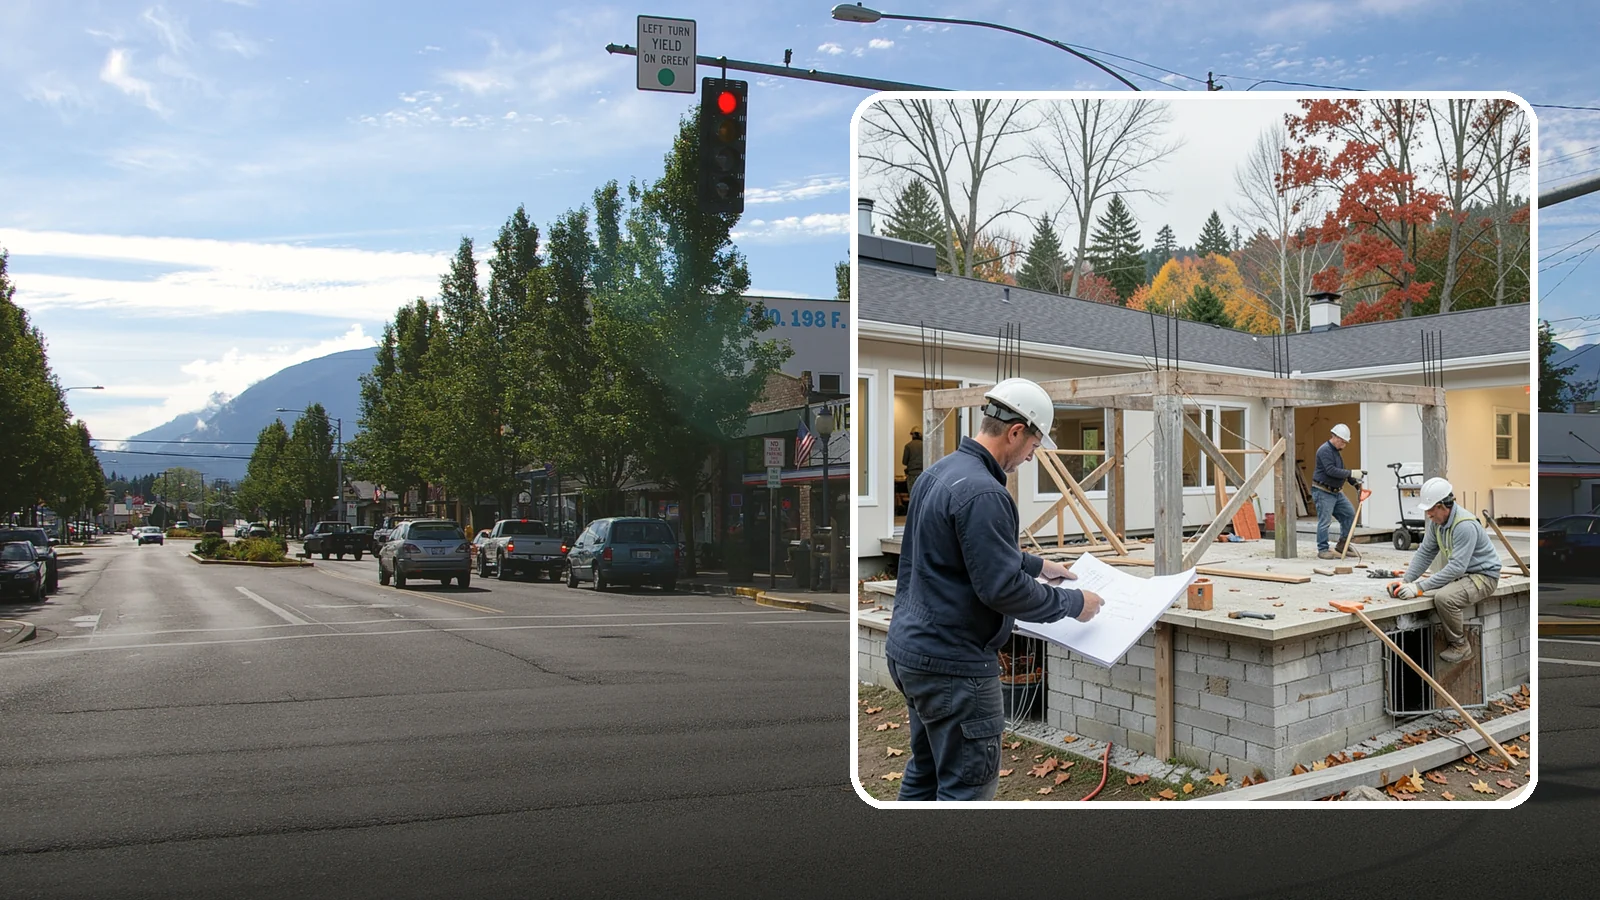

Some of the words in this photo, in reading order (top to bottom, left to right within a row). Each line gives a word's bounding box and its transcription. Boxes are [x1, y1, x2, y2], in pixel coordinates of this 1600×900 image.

[642, 23, 663, 34] LEFT
[668, 25, 690, 36] TURN
[652, 38, 682, 51] YIELD
[644, 53, 656, 63] ON
[661, 55, 689, 66] GREEN
[791, 309, 826, 328] 198
[831, 311, 846, 329] F.
